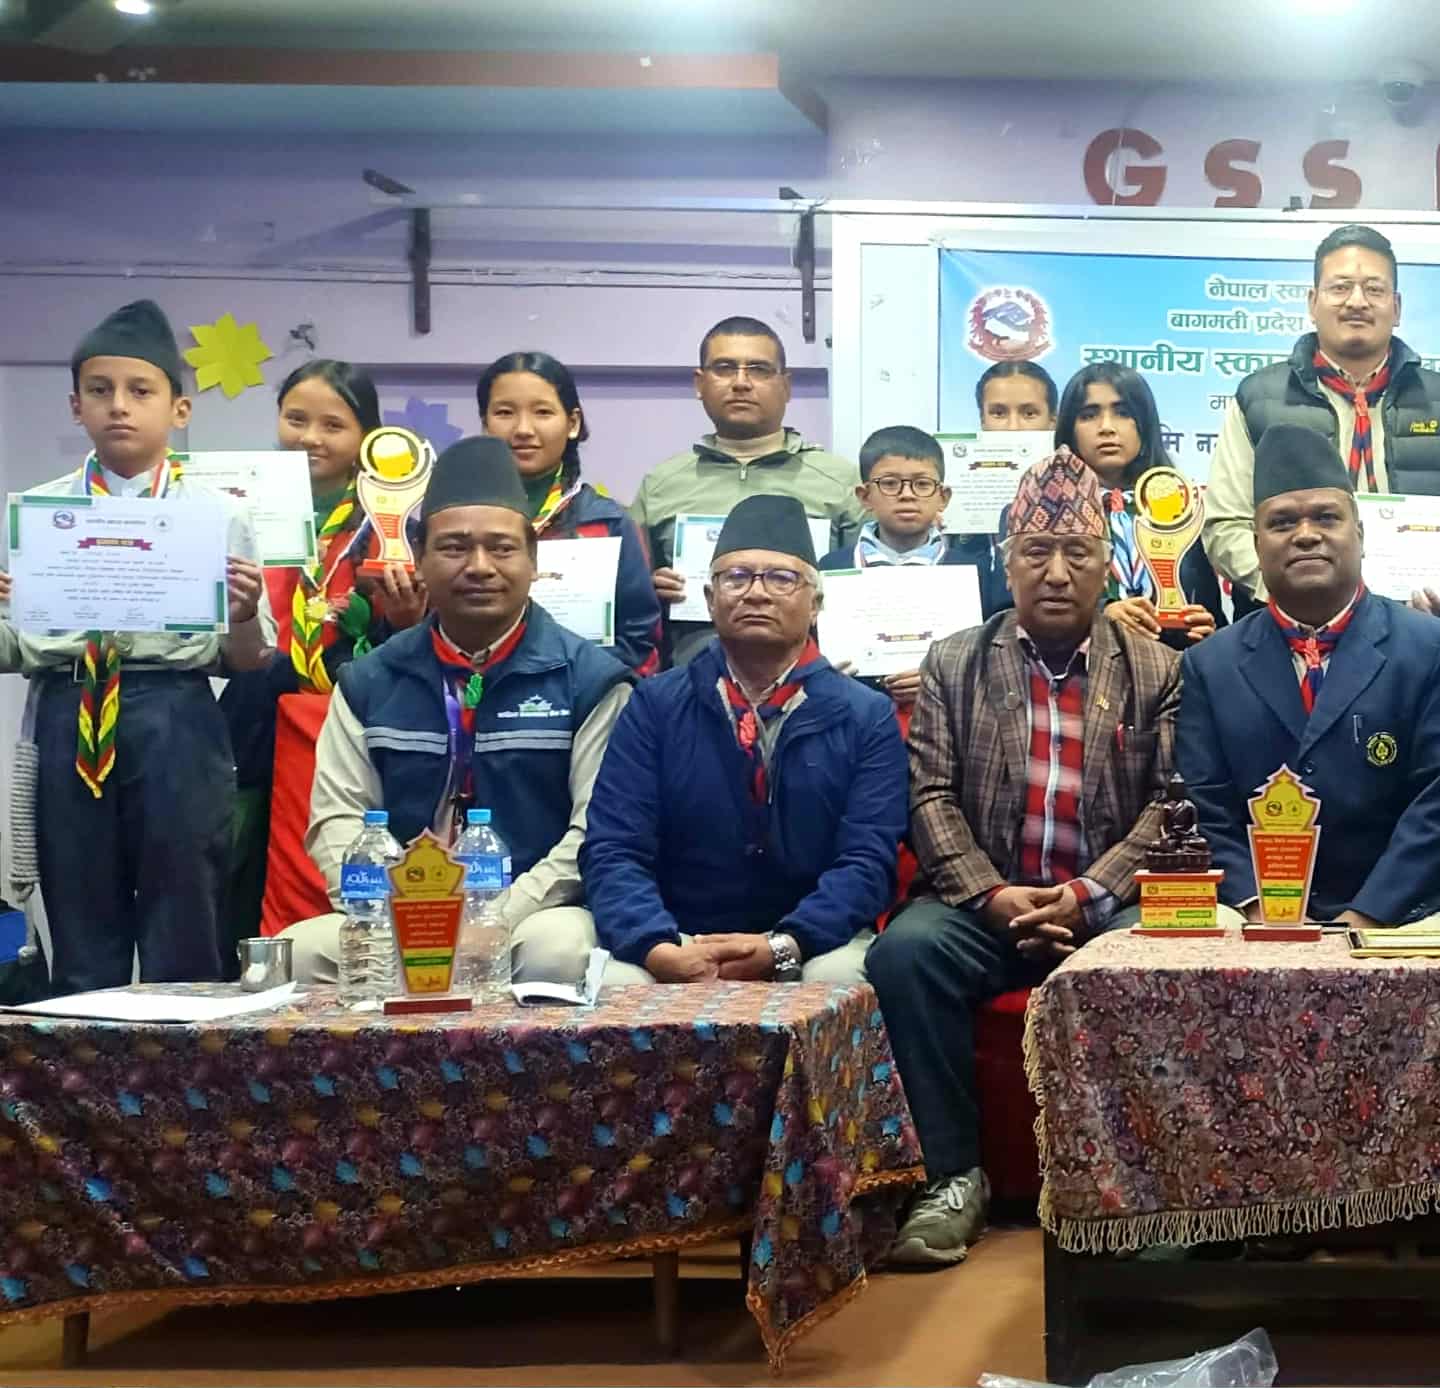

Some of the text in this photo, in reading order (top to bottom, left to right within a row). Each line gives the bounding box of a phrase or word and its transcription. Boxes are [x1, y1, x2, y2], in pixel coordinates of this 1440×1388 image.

[1208, 278, 1268, 298] नेपाल
[1170, 311, 1304, 332] बागमती प्रदेश
